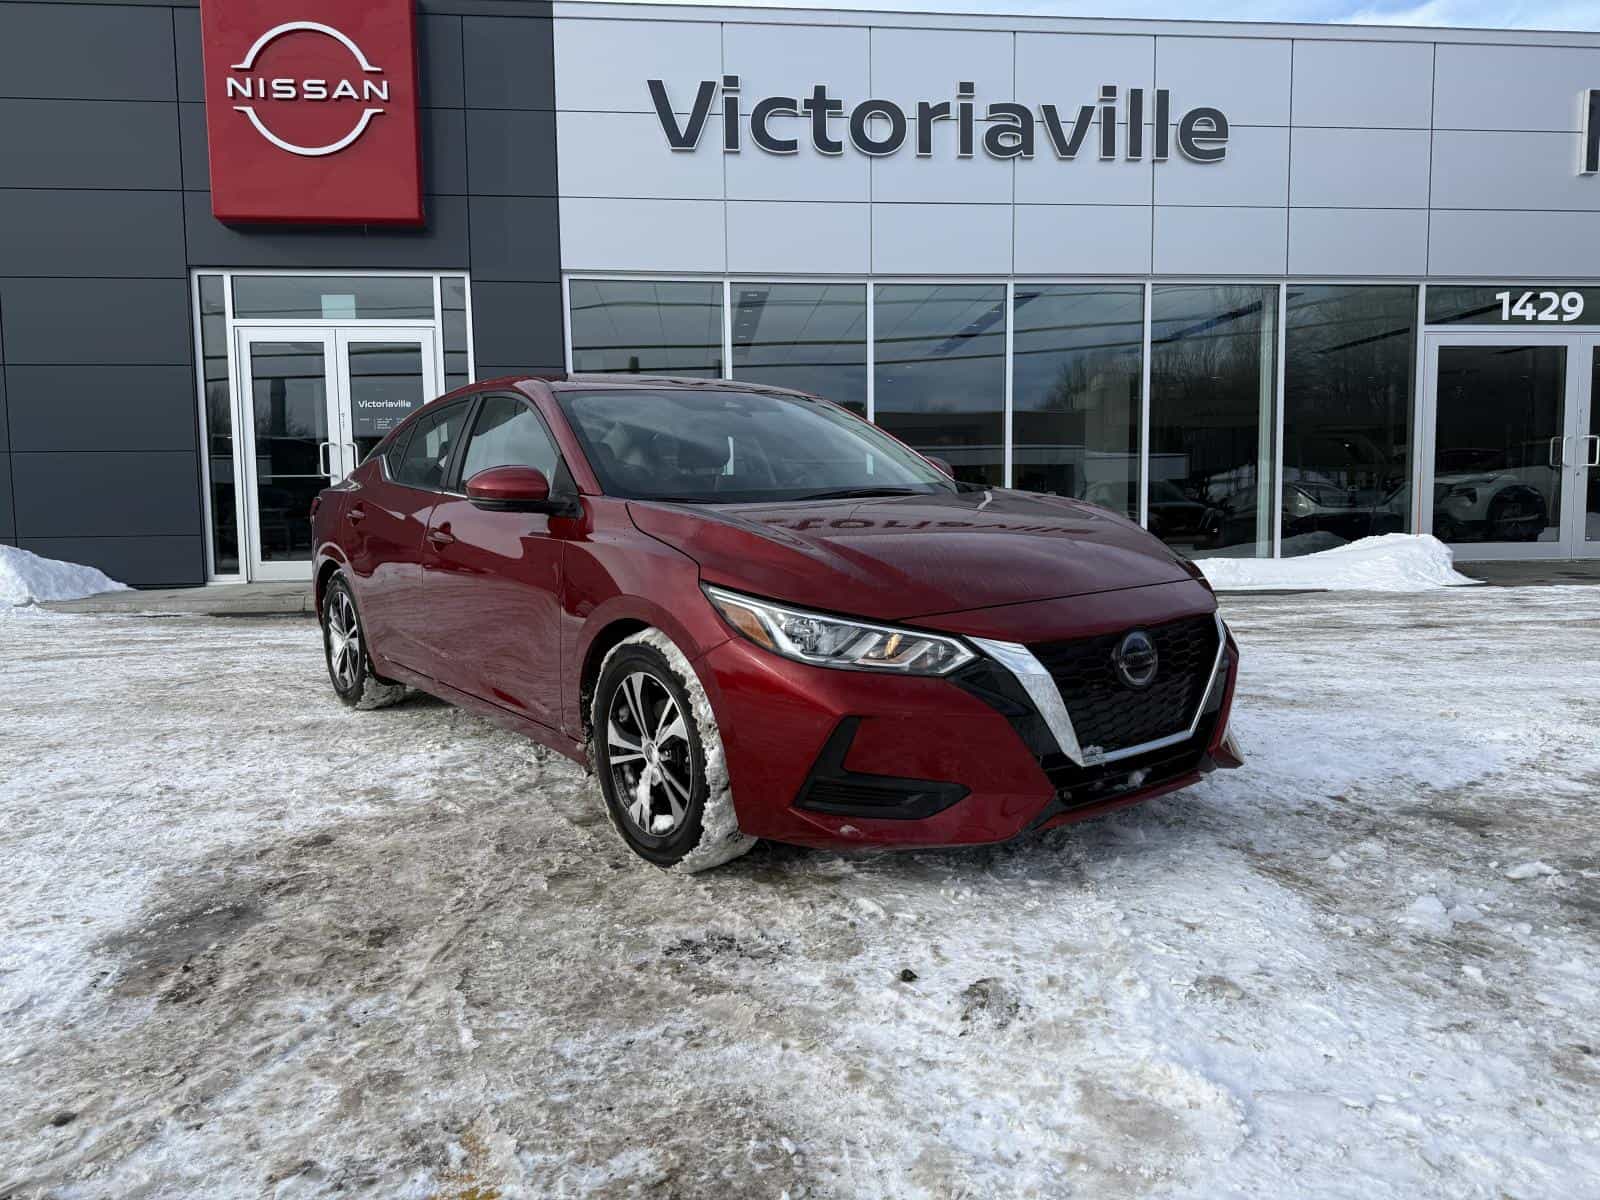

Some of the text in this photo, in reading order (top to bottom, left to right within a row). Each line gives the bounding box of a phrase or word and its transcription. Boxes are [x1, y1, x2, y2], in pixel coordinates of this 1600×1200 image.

[226, 77, 389, 100] NISSAN
[646, 74, 1230, 163] Victoriaville
[1495, 290, 1585, 322] 1429
[358, 399, 412, 408] Victoriaville
